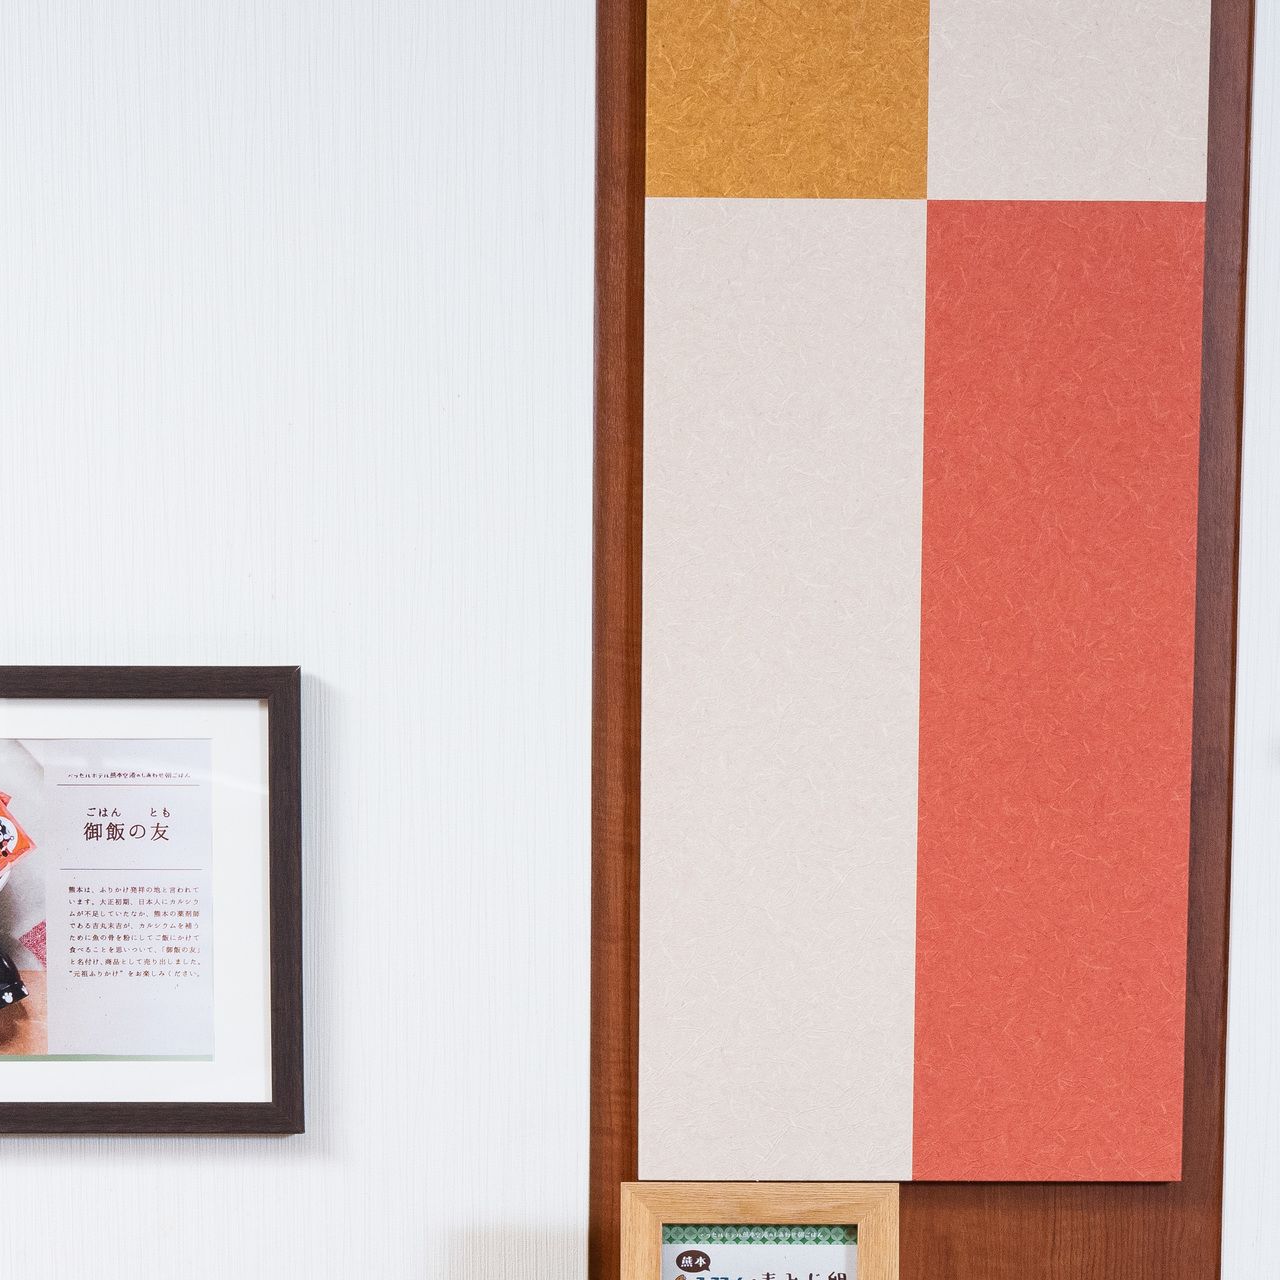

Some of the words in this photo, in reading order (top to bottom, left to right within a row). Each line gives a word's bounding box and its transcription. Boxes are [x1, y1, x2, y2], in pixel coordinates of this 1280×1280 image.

[86, 807, 122, 818] ごはん
[150, 807, 171, 818] とも
[83, 822, 169, 841] 御飯の友
[681, 1257, 706, 1268] 熊本
